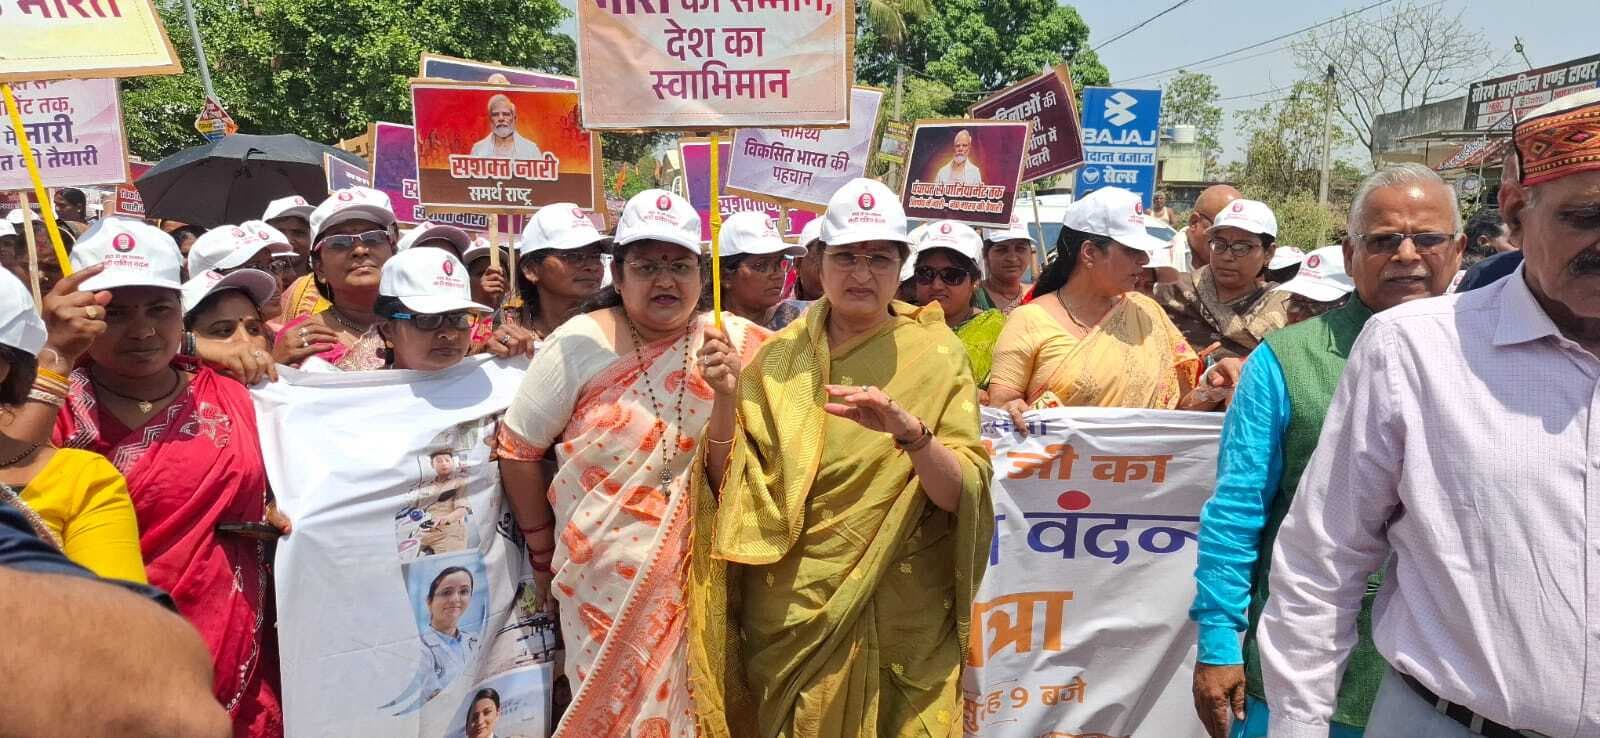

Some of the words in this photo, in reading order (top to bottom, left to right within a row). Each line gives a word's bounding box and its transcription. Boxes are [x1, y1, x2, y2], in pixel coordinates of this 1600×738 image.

[664, 19, 716, 61] देश
[722, 27, 766, 57] का
[650, 60, 790, 100] स्वाभिमान
[37, 97, 74, 113] तक,
[1042, 91, 1057, 108] की
[1082, 128, 1156, 146] BAJAJ
[46, 145, 98, 168] तैयारी
[450, 155, 513, 178] सशक्त
[513, 152, 559, 181] नारी
[744, 138, 795, 162] विकसित
[797, 150, 828, 168] भारत
[831, 151, 850, 172] की
[773, 167, 813, 186] पहचान
[468, 182, 503, 202] समर्थ
[504, 187, 533, 206] राष्ट्र
[1006, 444, 1079, 481] जी
[1091, 454, 1174, 483] का
[1010, 687, 1029, 708] 9
[1040, 676, 1087, 705] बजे
